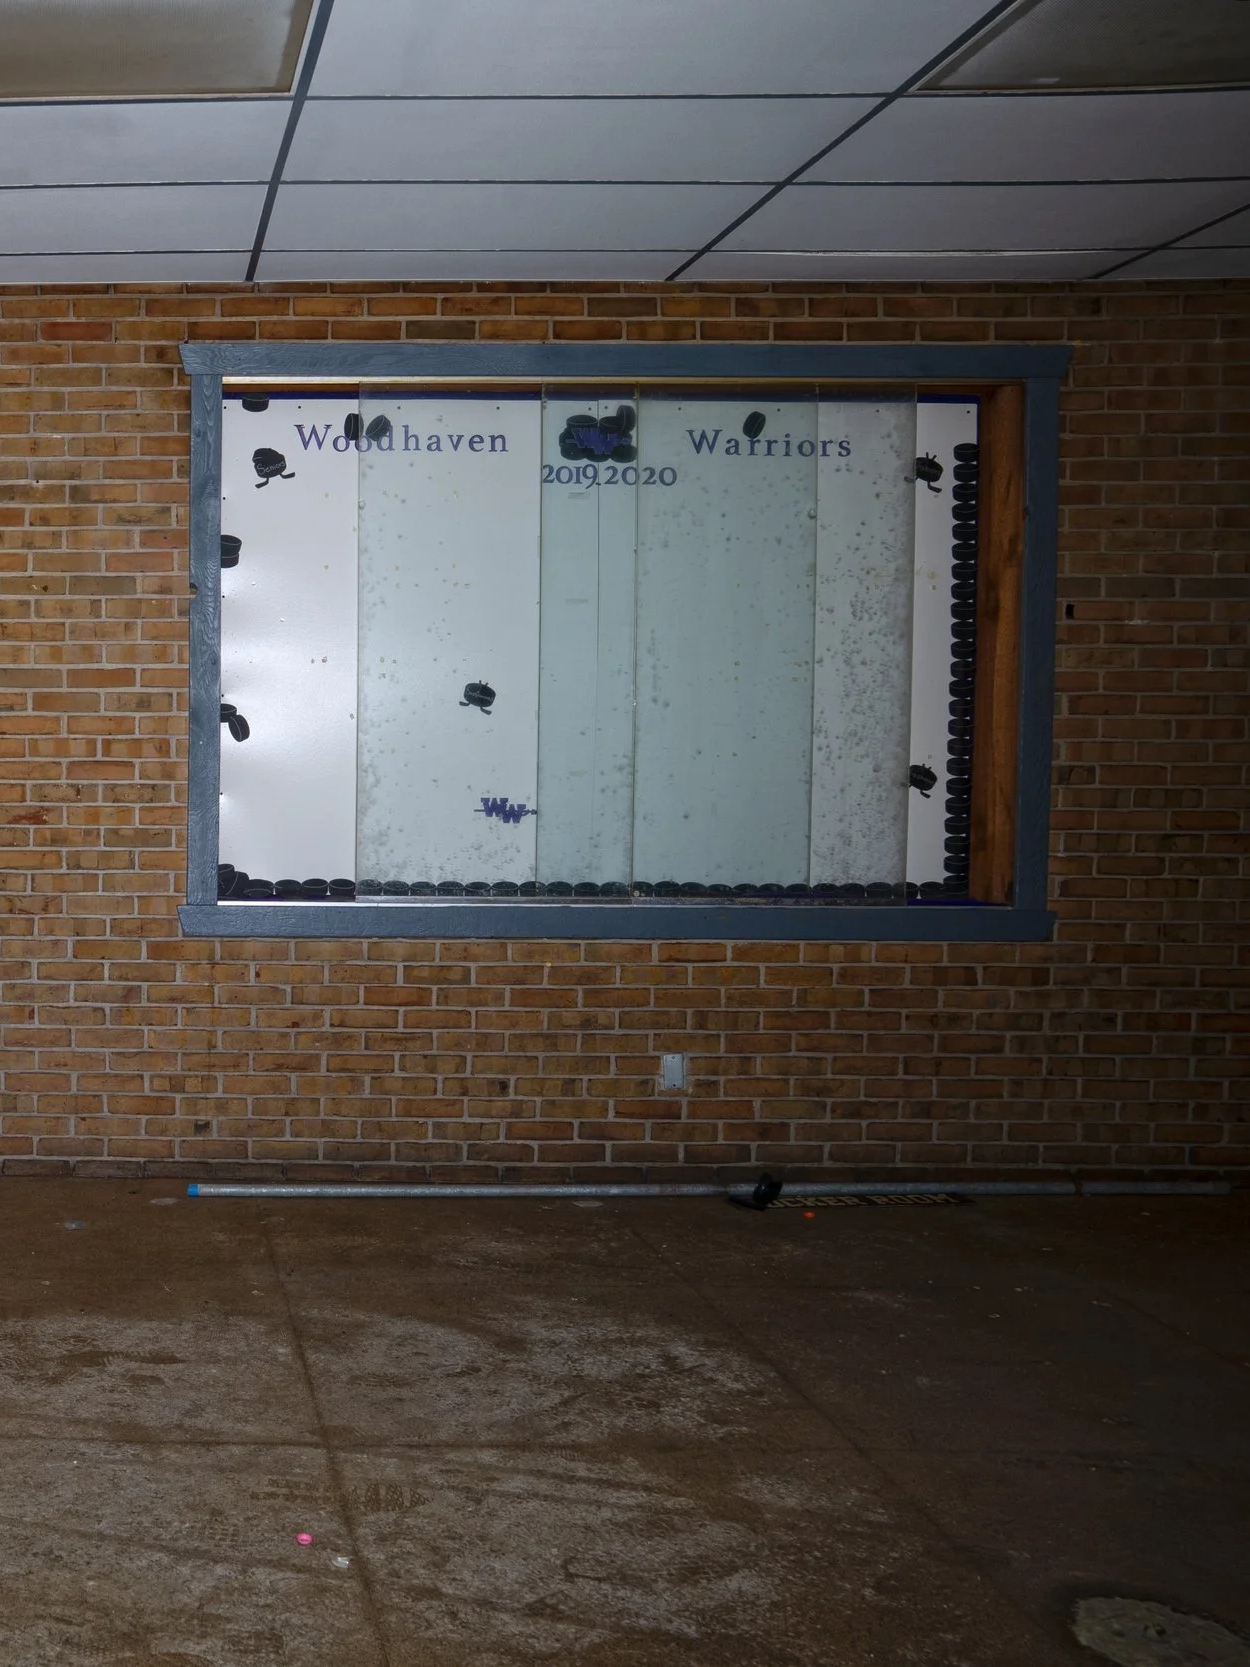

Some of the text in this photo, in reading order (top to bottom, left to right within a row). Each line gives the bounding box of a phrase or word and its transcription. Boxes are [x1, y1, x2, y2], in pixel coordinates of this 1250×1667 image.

[294, 424, 852, 457] Woodhaven Warriors
[256, 461, 286, 474] Seniors
[766, 1193, 958, 1209] OCKER ROOM
